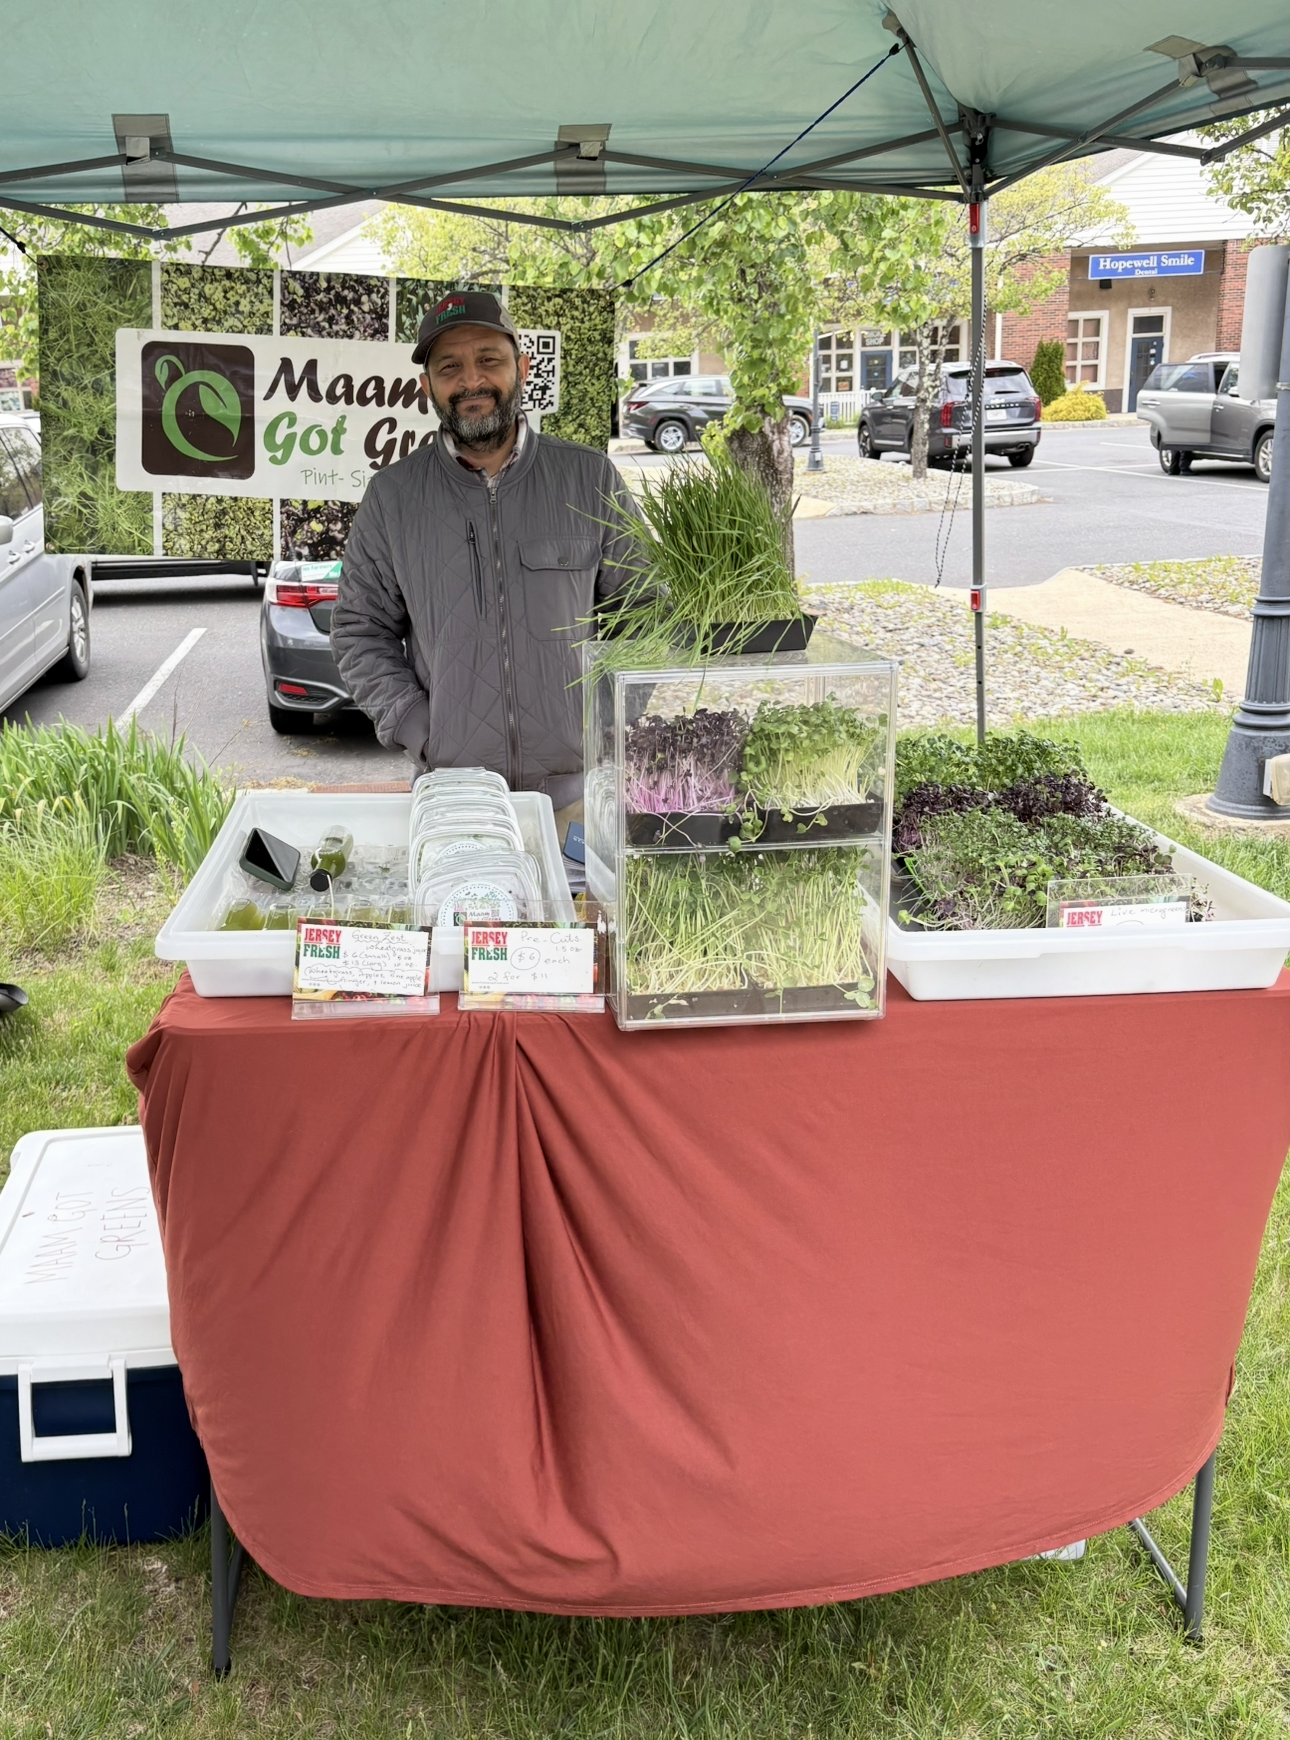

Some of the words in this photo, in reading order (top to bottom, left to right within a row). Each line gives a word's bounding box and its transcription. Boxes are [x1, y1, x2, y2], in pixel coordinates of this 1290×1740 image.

[1098, 255, 1158, 272] Hopewell
[1160, 253, 1195, 267] Smile
[435, 305, 466, 325] FRESH
[263, 411, 347, 466] Got
[300, 467, 345, 486] Pint-
[350, 469, 373, 488] Si
[1066, 910, 1103, 926] JERSEY
[1110, 906, 1137, 917] Live
[303, 928, 342, 943] JERSEY
[351, 929, 379, 941] Green
[382, 932, 407, 943] Zest
[471, 931, 508, 945] JERSEY
[303, 943, 340, 959] FRESH
[471, 947, 508, 961] FRESH
[544, 956, 571, 965] each
[487, 971, 499, 981] 2
[503, 971, 521, 981] for
[47, 1191, 99, 1223] GOT
[94, 1186, 151, 1261] GREENS
[22, 1227, 84, 1285] MAAM
